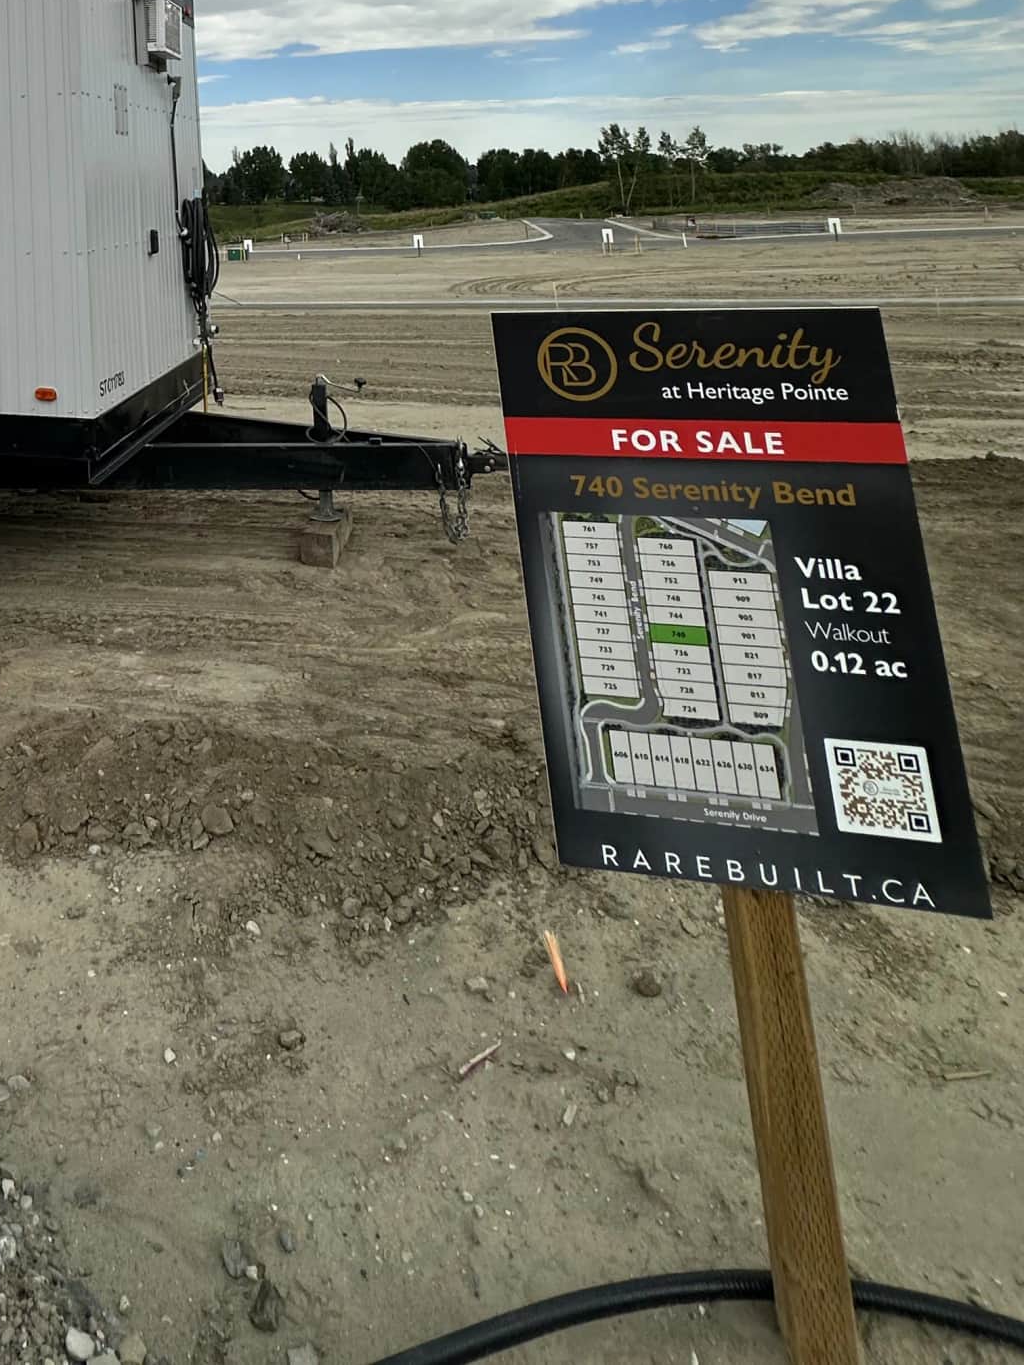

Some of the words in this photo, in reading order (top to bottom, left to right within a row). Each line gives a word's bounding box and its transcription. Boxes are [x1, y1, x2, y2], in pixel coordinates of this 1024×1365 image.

[629, 322, 842, 384] Serenity
[661, 385, 681, 400] at
[687, 383, 775, 405] Heritage
[781, 383, 849, 401] Pointe
[611, 429, 683, 453] FOR
[695, 430, 785, 455] SALE
[570, 475, 624, 498] 740
[632, 477, 761, 509] Serenity
[772, 481, 857, 507] Bend
[794, 556, 862, 580] Villa
[801, 587, 854, 611] Lot
[863, 591, 901, 614] 22
[804, 620, 892, 644] Walkout
[811, 650, 866, 675] 0.12
[875, 660, 908, 678] ac
[704, 808, 740, 820] Serenity
[743, 812, 767, 823] Drive
[601, 844, 936, 908] RAREBUILT.CA
